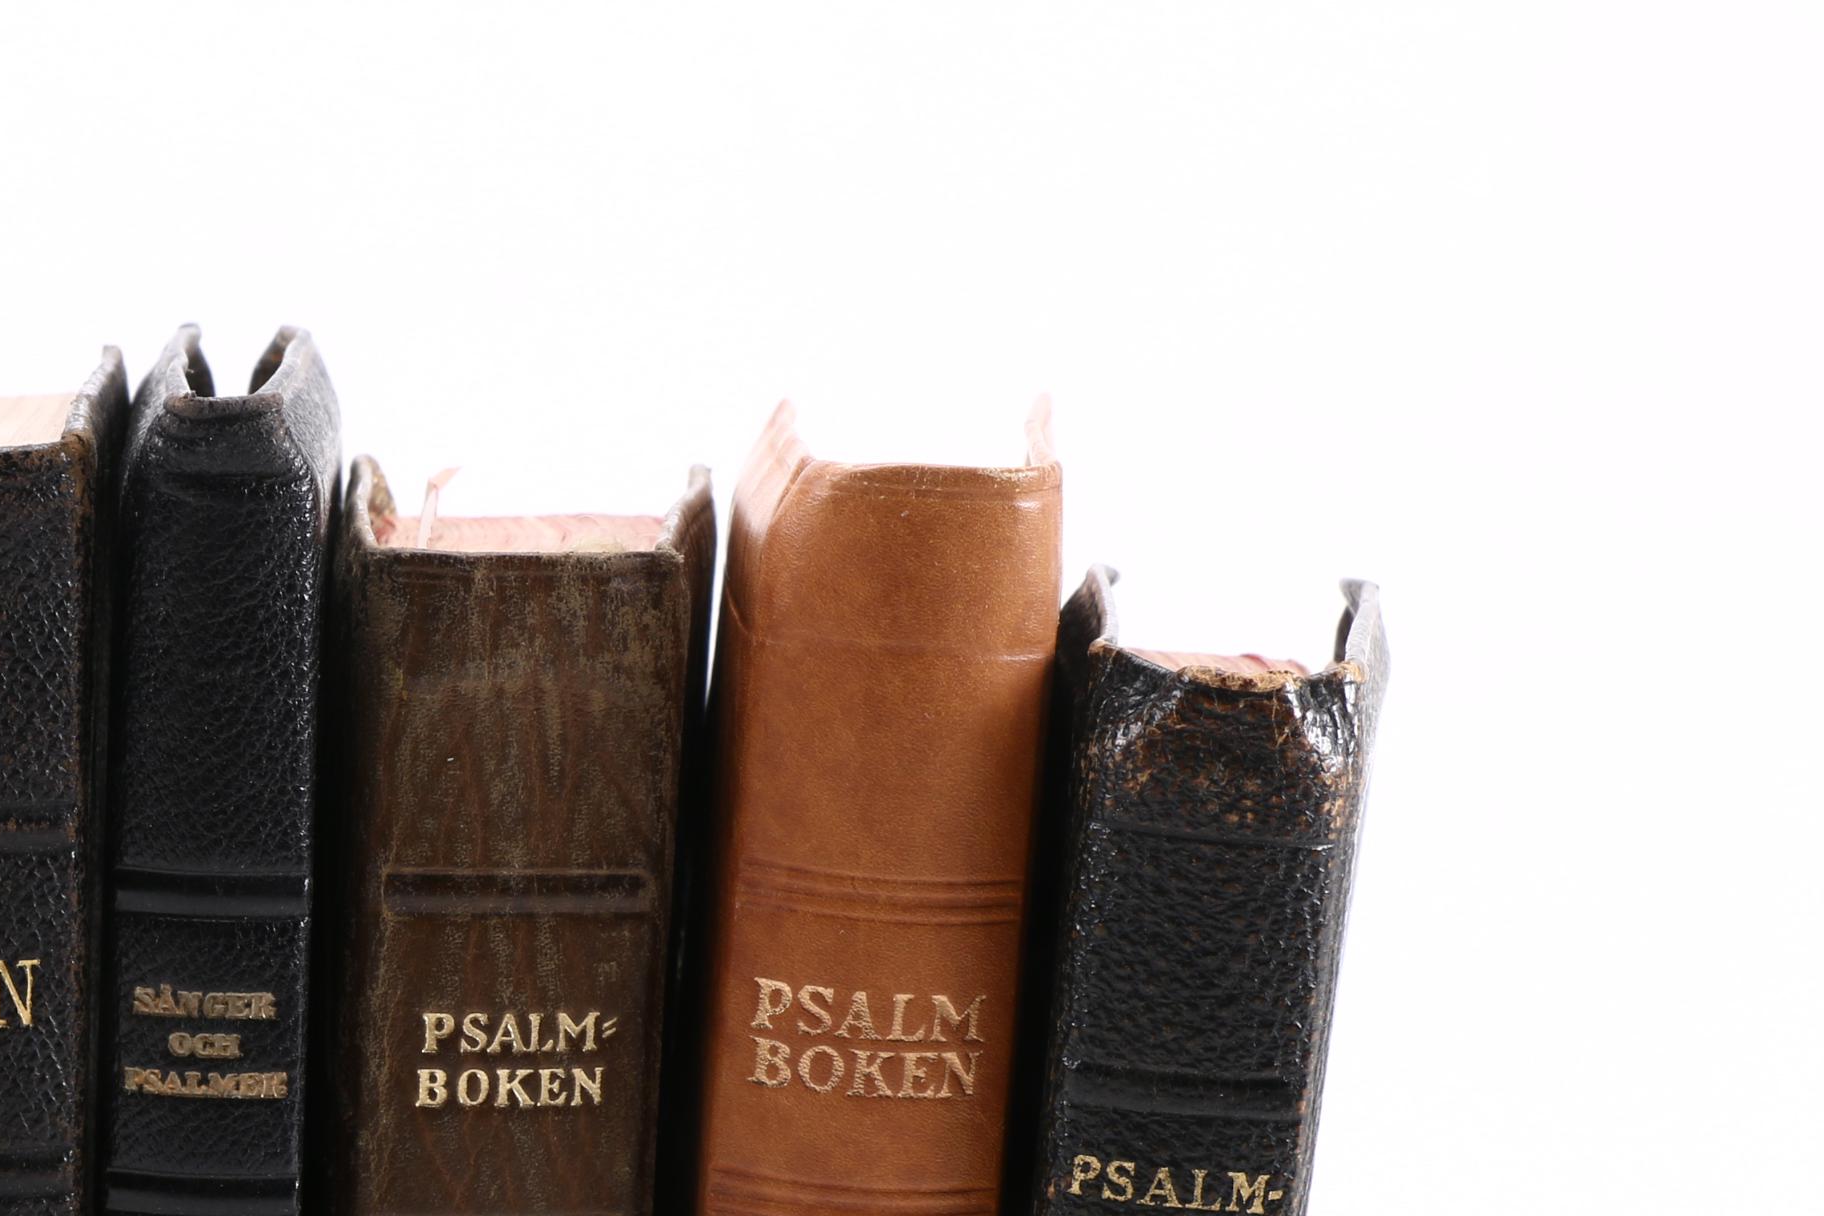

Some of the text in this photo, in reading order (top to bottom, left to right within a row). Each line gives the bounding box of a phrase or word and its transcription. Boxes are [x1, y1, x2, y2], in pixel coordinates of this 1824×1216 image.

[133, 983, 277, 1020] SÅNGER
[750, 977, 987, 1043] PSALM
[168, 1032, 242, 1059] OCH
[124, 1066, 288, 1098] PSALMER
[415, 1066, 605, 1107] BOKEN
[745, 1035, 984, 1098] BOKEN
[1066, 1154, 1284, 1215] PSALM-
